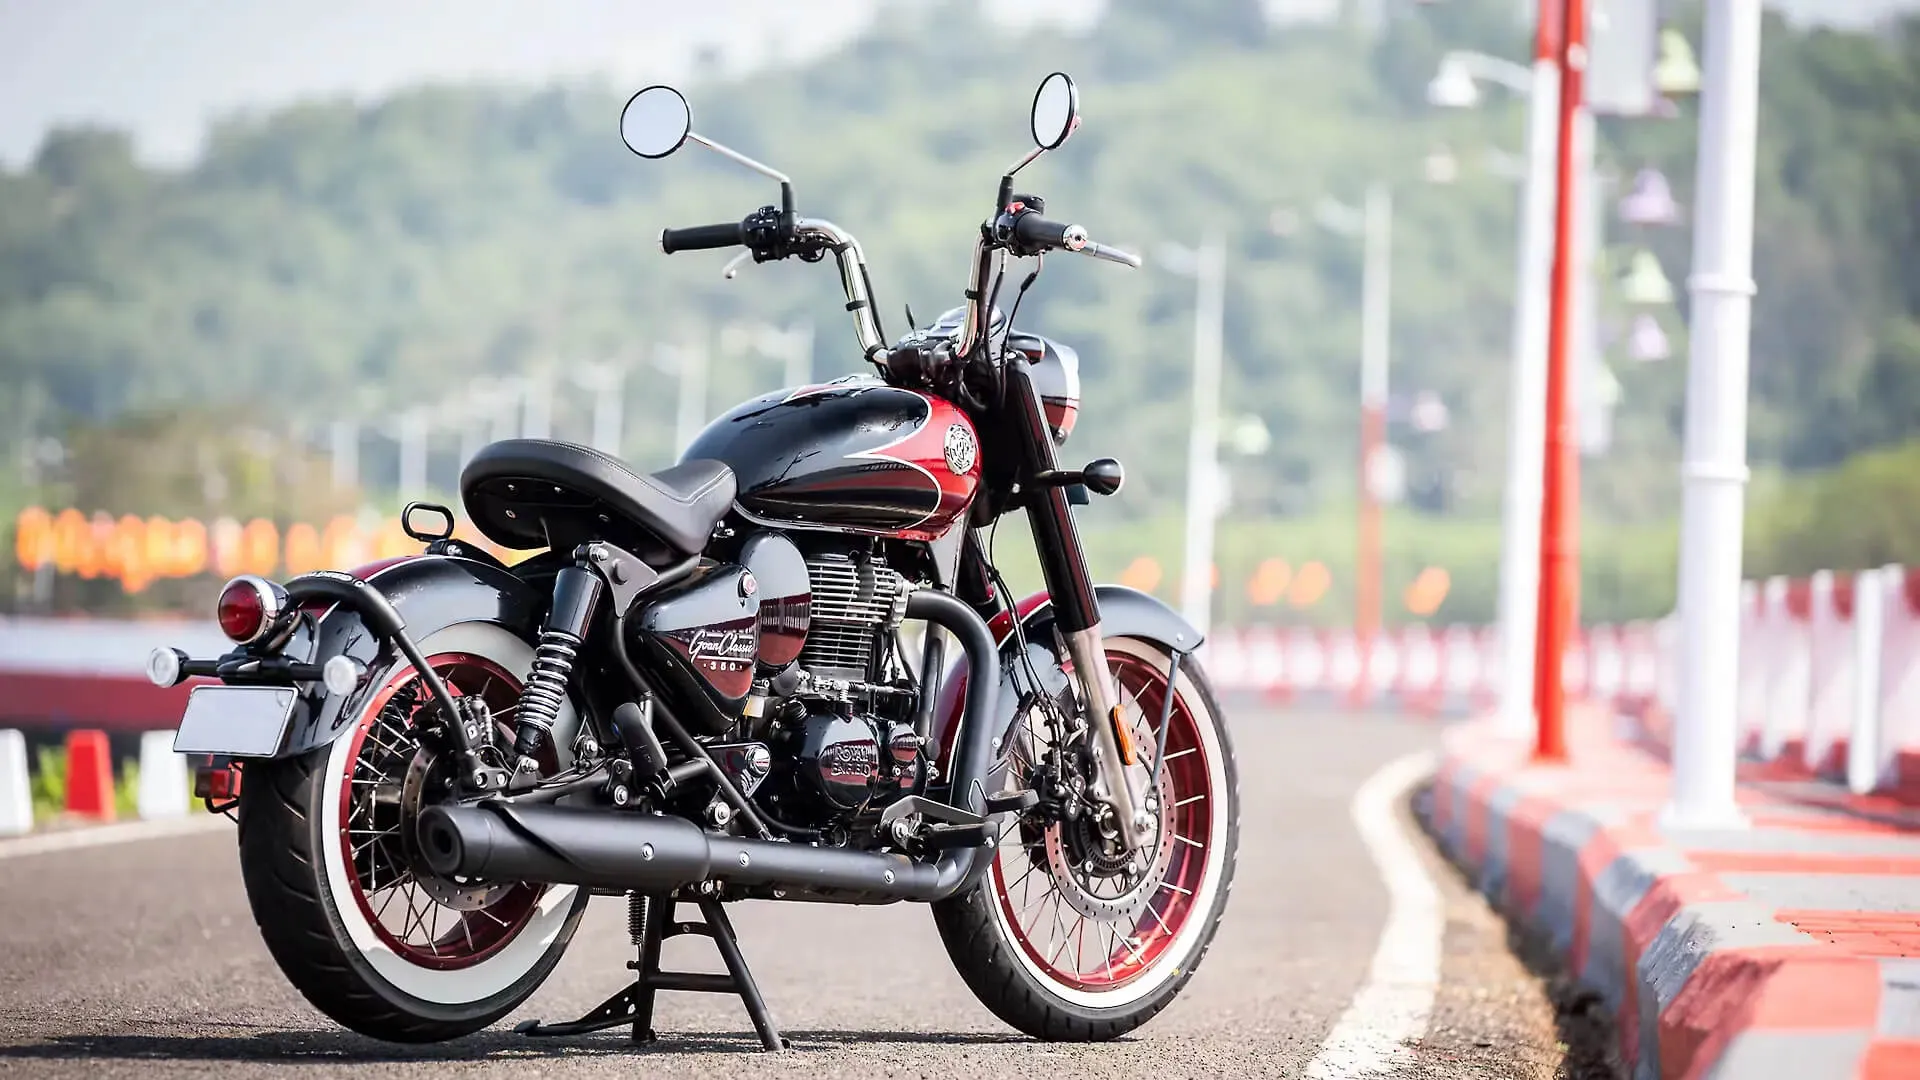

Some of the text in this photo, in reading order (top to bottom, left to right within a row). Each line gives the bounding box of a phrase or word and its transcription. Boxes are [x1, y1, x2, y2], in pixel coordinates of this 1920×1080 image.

[688, 629, 755, 664] Goan Classic
[833, 743, 869, 762] ROYAL
